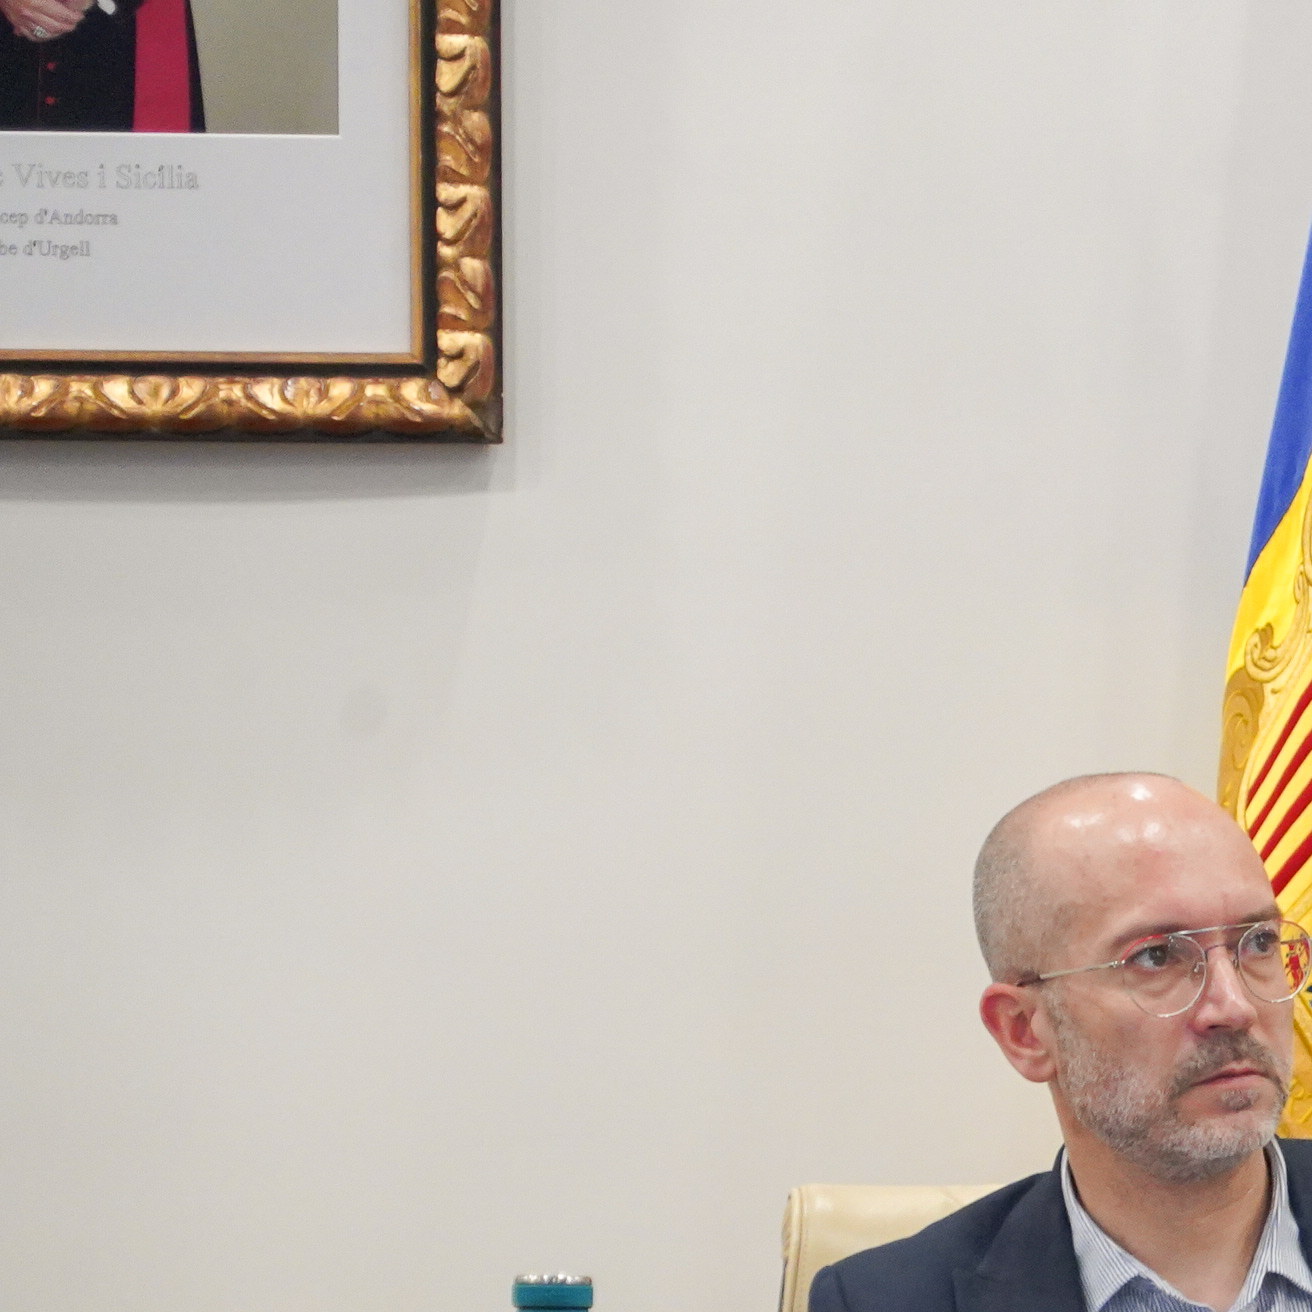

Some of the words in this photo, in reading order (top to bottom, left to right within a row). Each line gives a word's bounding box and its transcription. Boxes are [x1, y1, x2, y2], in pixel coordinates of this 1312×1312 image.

[11, 163, 89, 189] Vives
[98, 163, 107, 189] i
[115, 163, 200, 190] Sicília
[0, 212, 29, 229] cep
[34, 208, 119, 226] d'Andorra
[0, 243, 18, 256] be
[22, 239, 91, 261] d'Urgell
